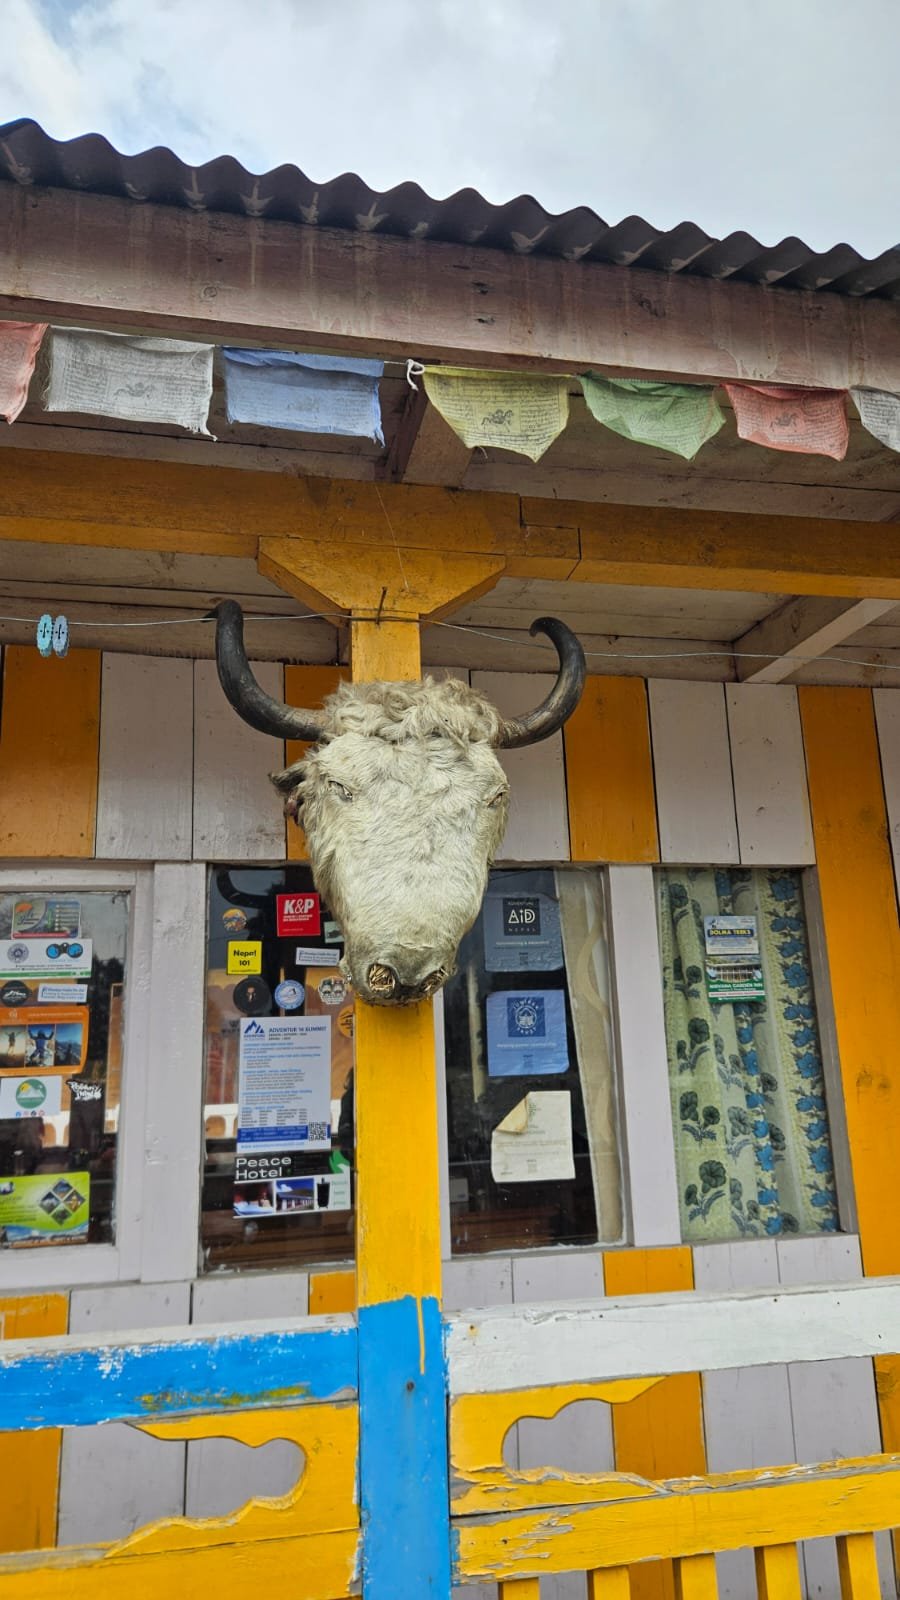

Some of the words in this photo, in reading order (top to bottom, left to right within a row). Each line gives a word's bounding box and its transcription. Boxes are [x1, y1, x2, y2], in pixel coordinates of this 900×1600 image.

[284, 899, 314, 914] K&P
[233, 949, 256, 957] Nepal
[236, 1156, 292, 1168] Peace
[236, 1166, 282, 1180] Hotel
